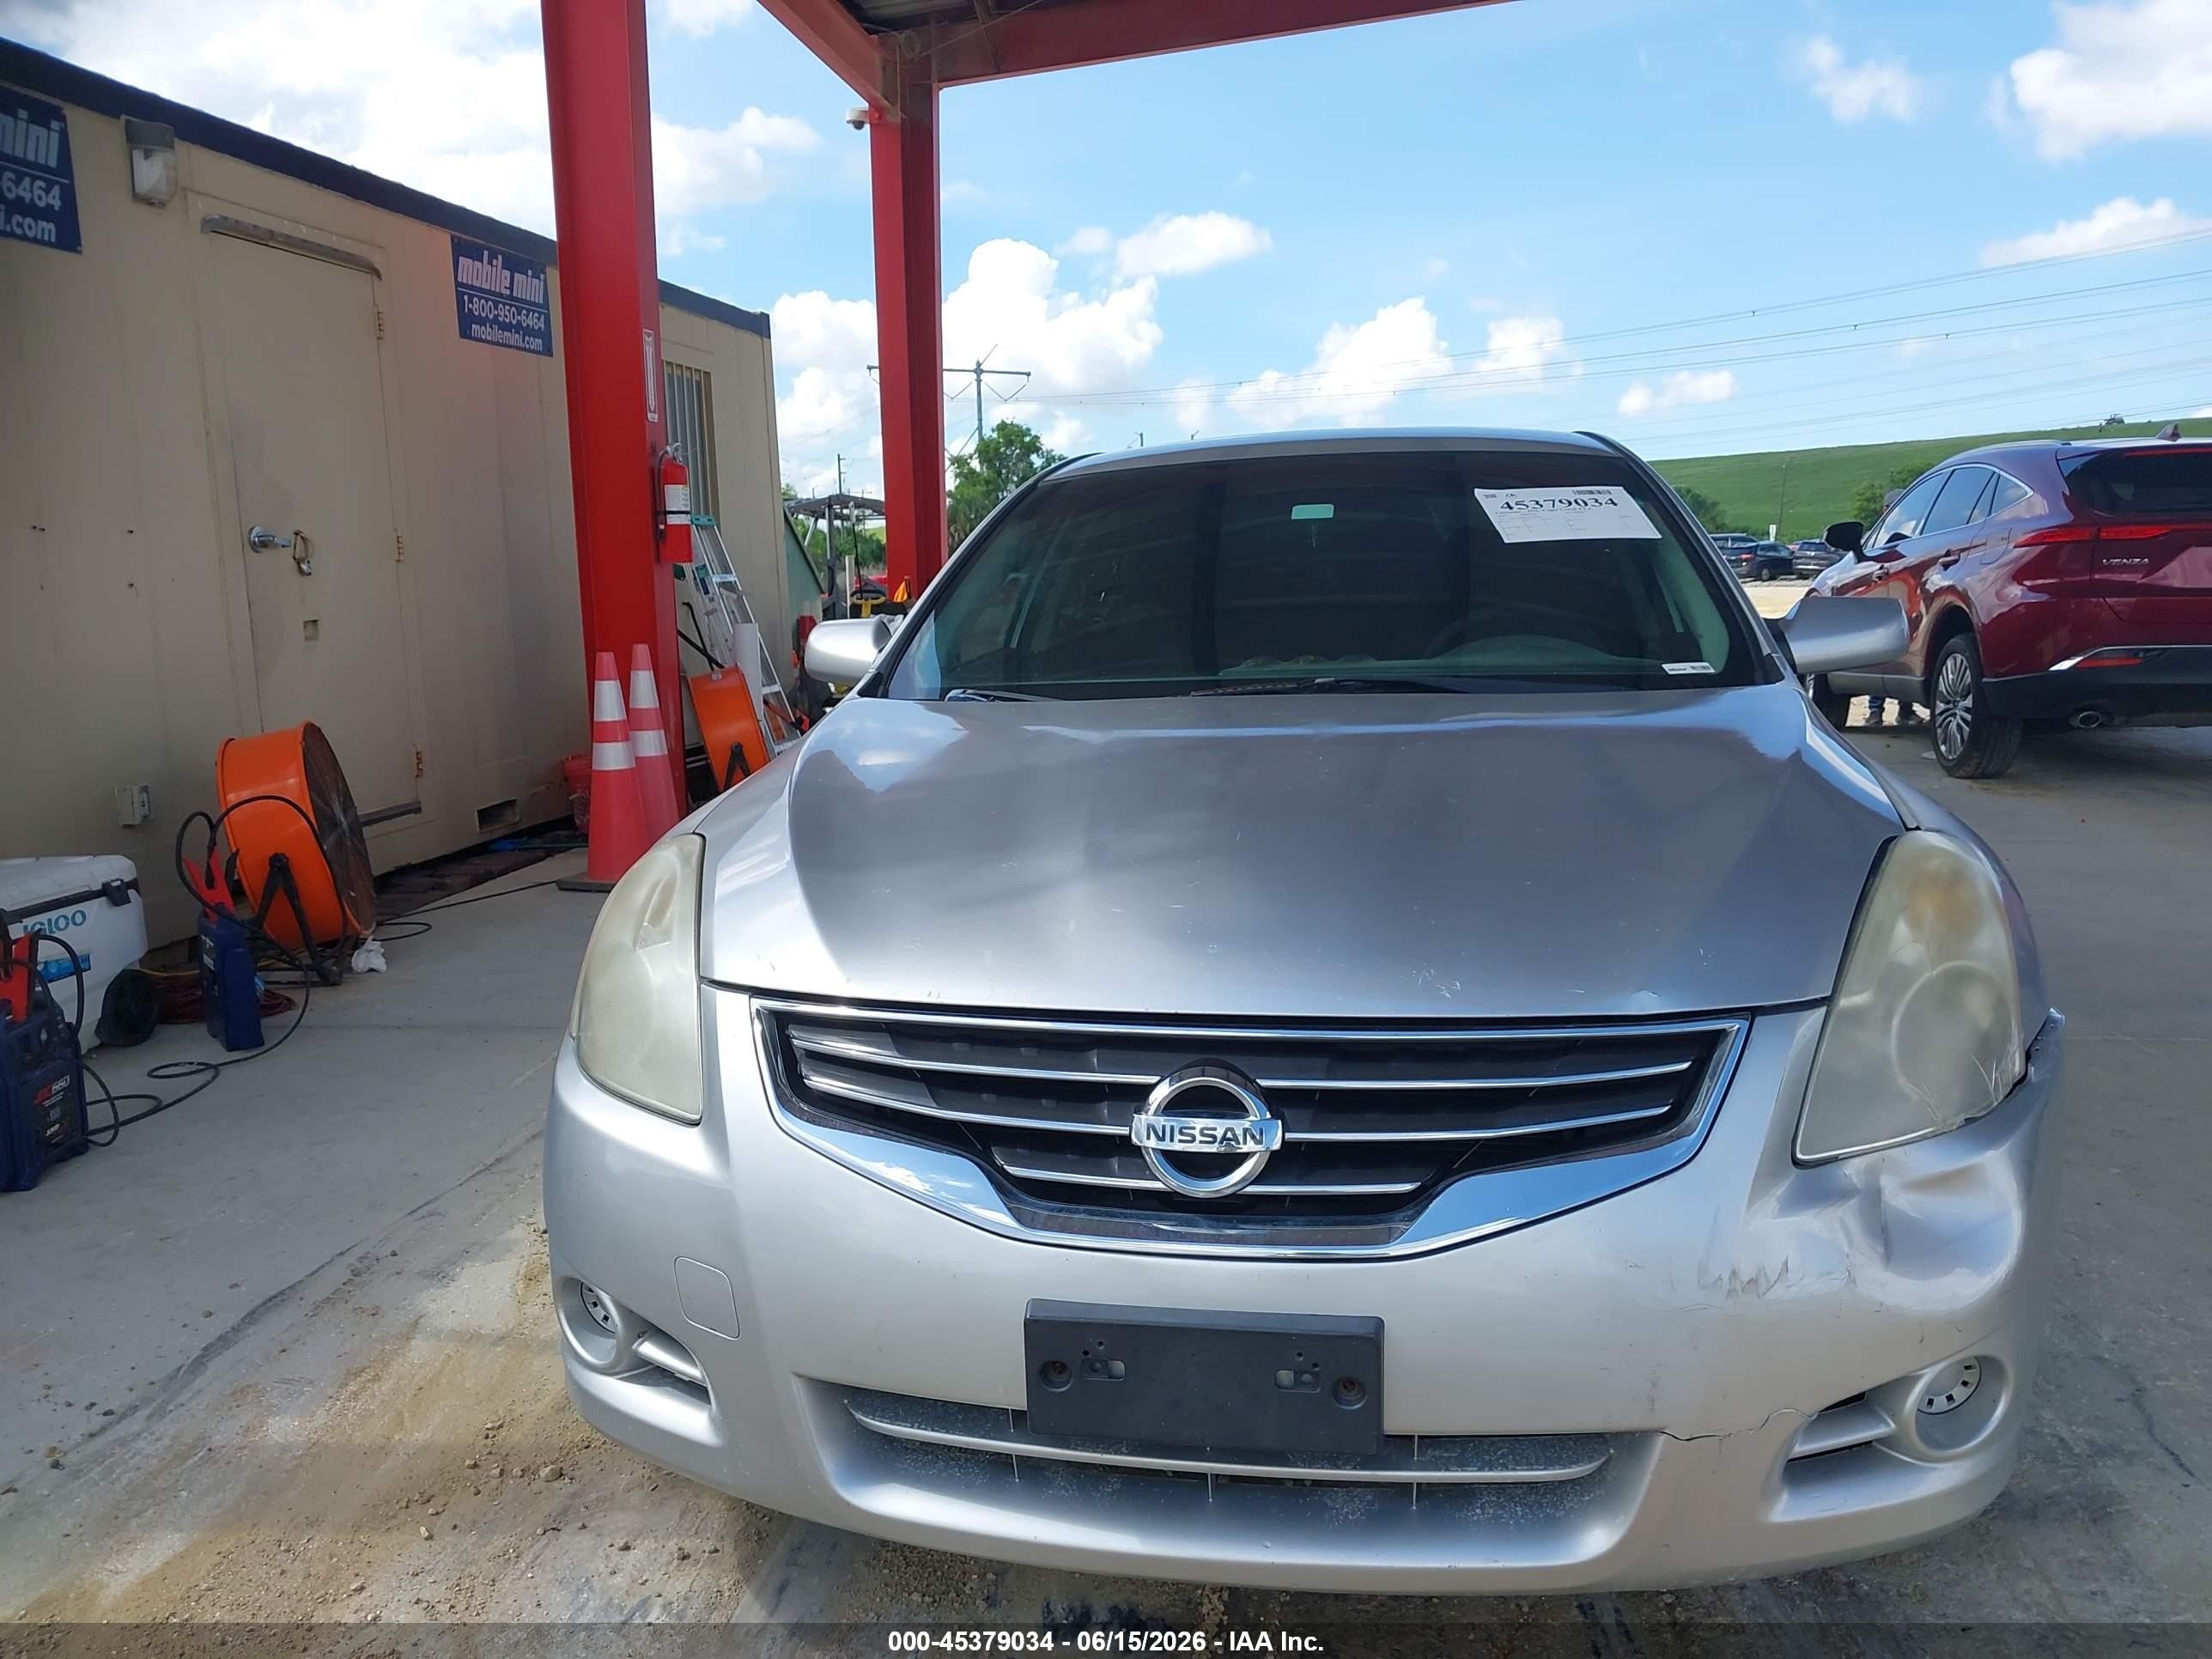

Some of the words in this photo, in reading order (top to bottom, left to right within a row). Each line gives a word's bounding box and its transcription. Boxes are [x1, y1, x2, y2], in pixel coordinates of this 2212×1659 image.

[458, 250, 511, 295] mobile
[513, 270, 544, 303] mini
[463, 295, 545, 331] 1-800-950-6464
[471, 323, 543, 351] mobilemini.com
[1500, 496, 1619, 511] 45379034
[1145, 1122, 1265, 1146] NISSAN
